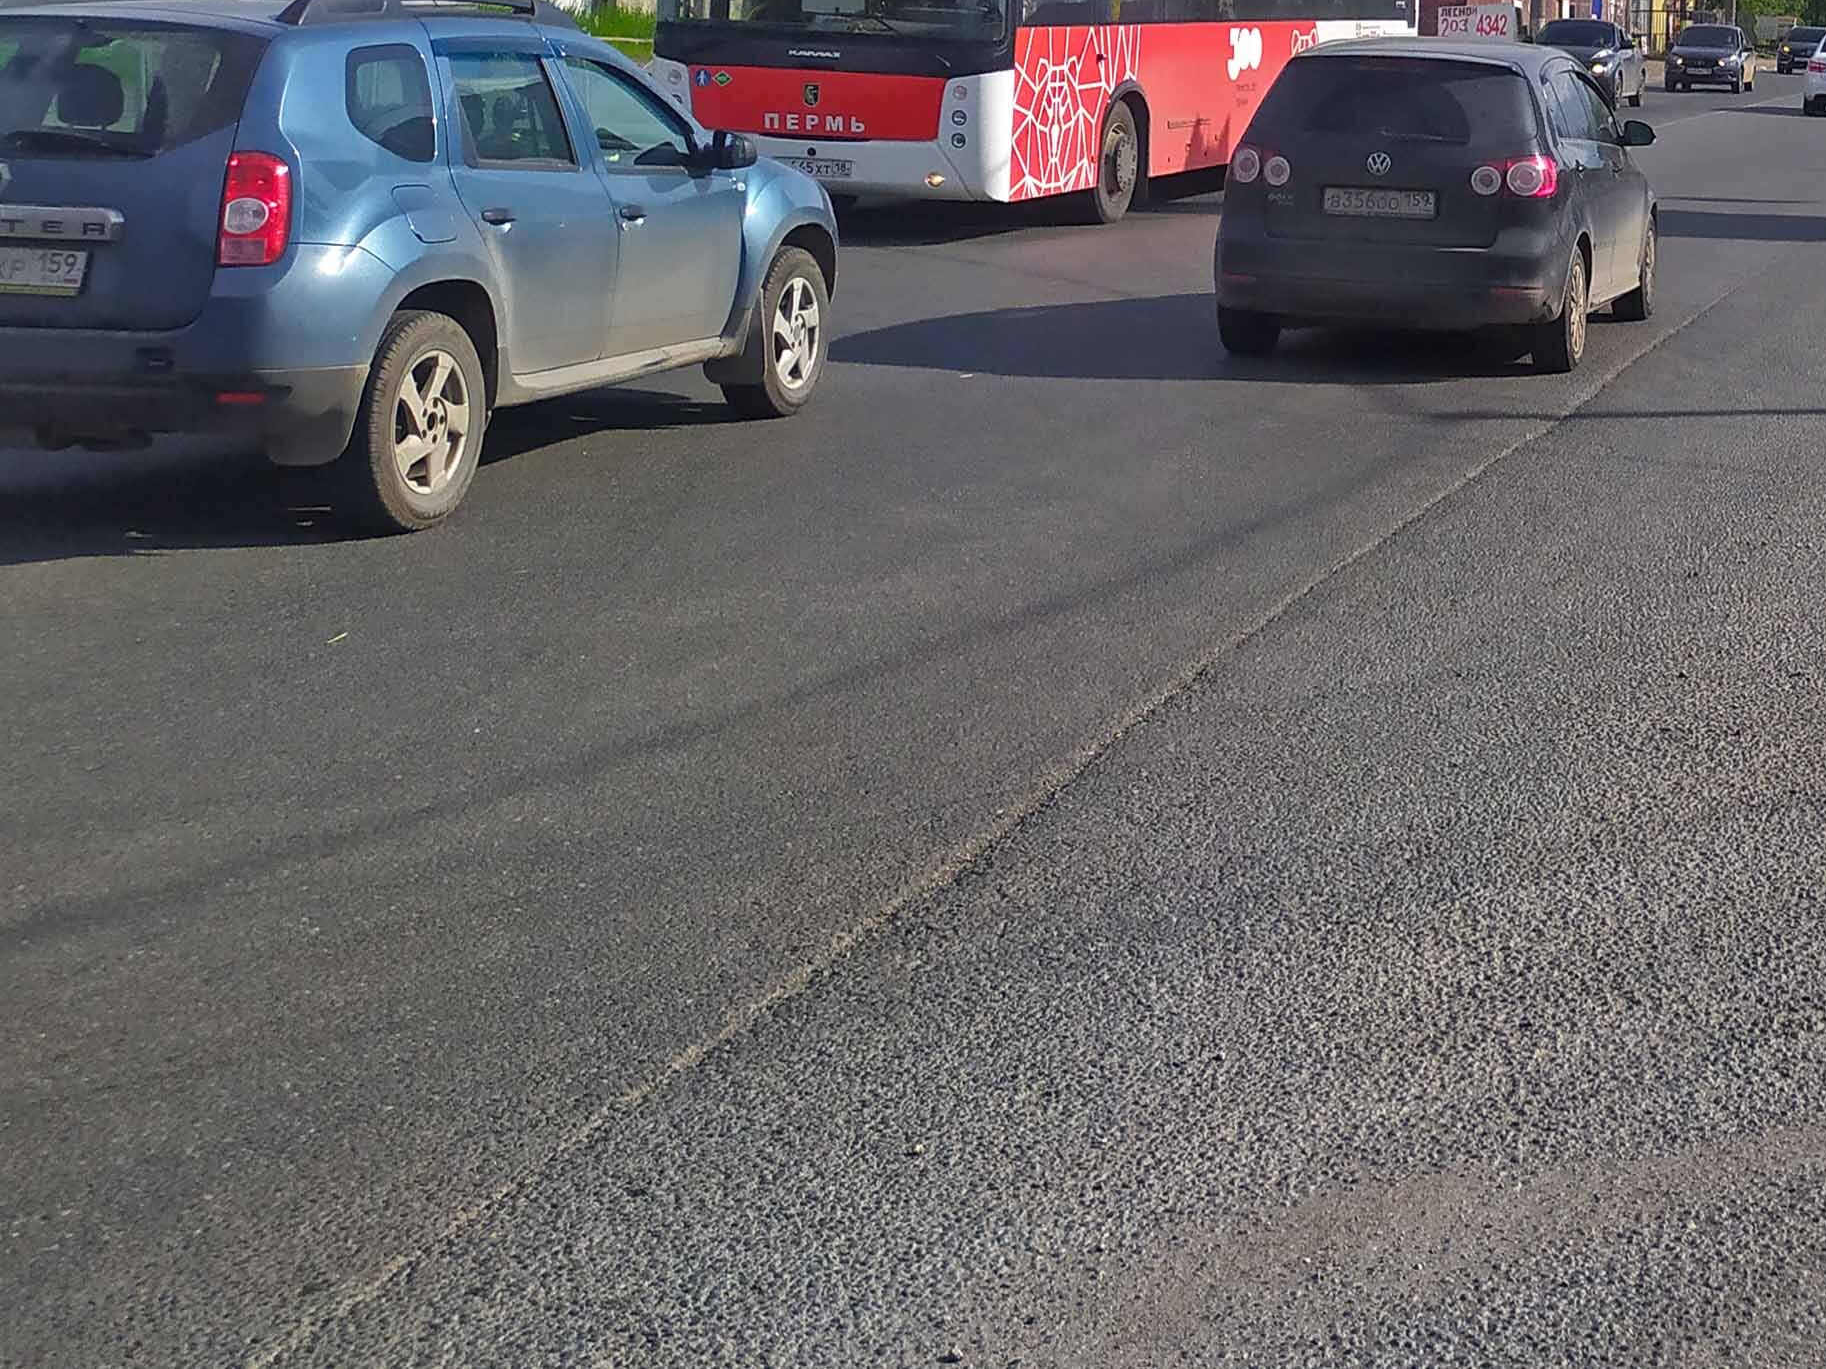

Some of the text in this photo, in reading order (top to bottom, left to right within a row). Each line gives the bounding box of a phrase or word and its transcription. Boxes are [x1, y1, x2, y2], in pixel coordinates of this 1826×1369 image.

[1475, 13, 1508, 36] 4342
[763, 112, 866, 134] ПЕРМЬ
[39, 252, 77, 275] 159
